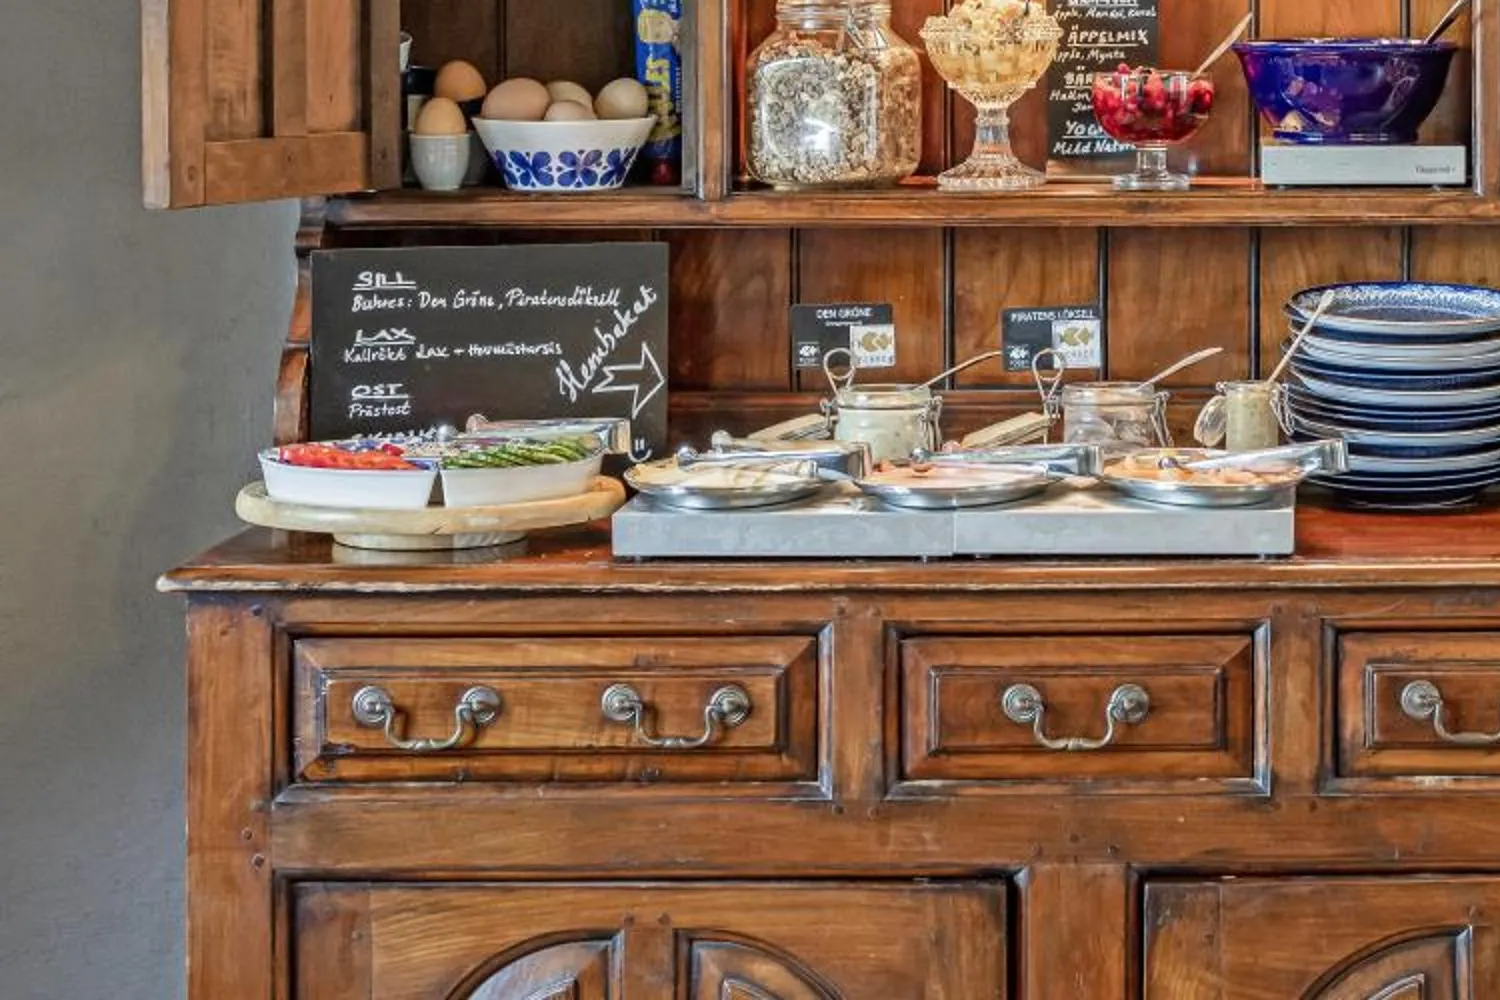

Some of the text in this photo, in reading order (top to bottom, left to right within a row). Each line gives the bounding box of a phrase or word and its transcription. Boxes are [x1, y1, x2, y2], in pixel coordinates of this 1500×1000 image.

[1067, 23, 1149, 45] ÄPPELMIX
[355, 327, 416, 342] LAX
[352, 383, 403, 396] OST
